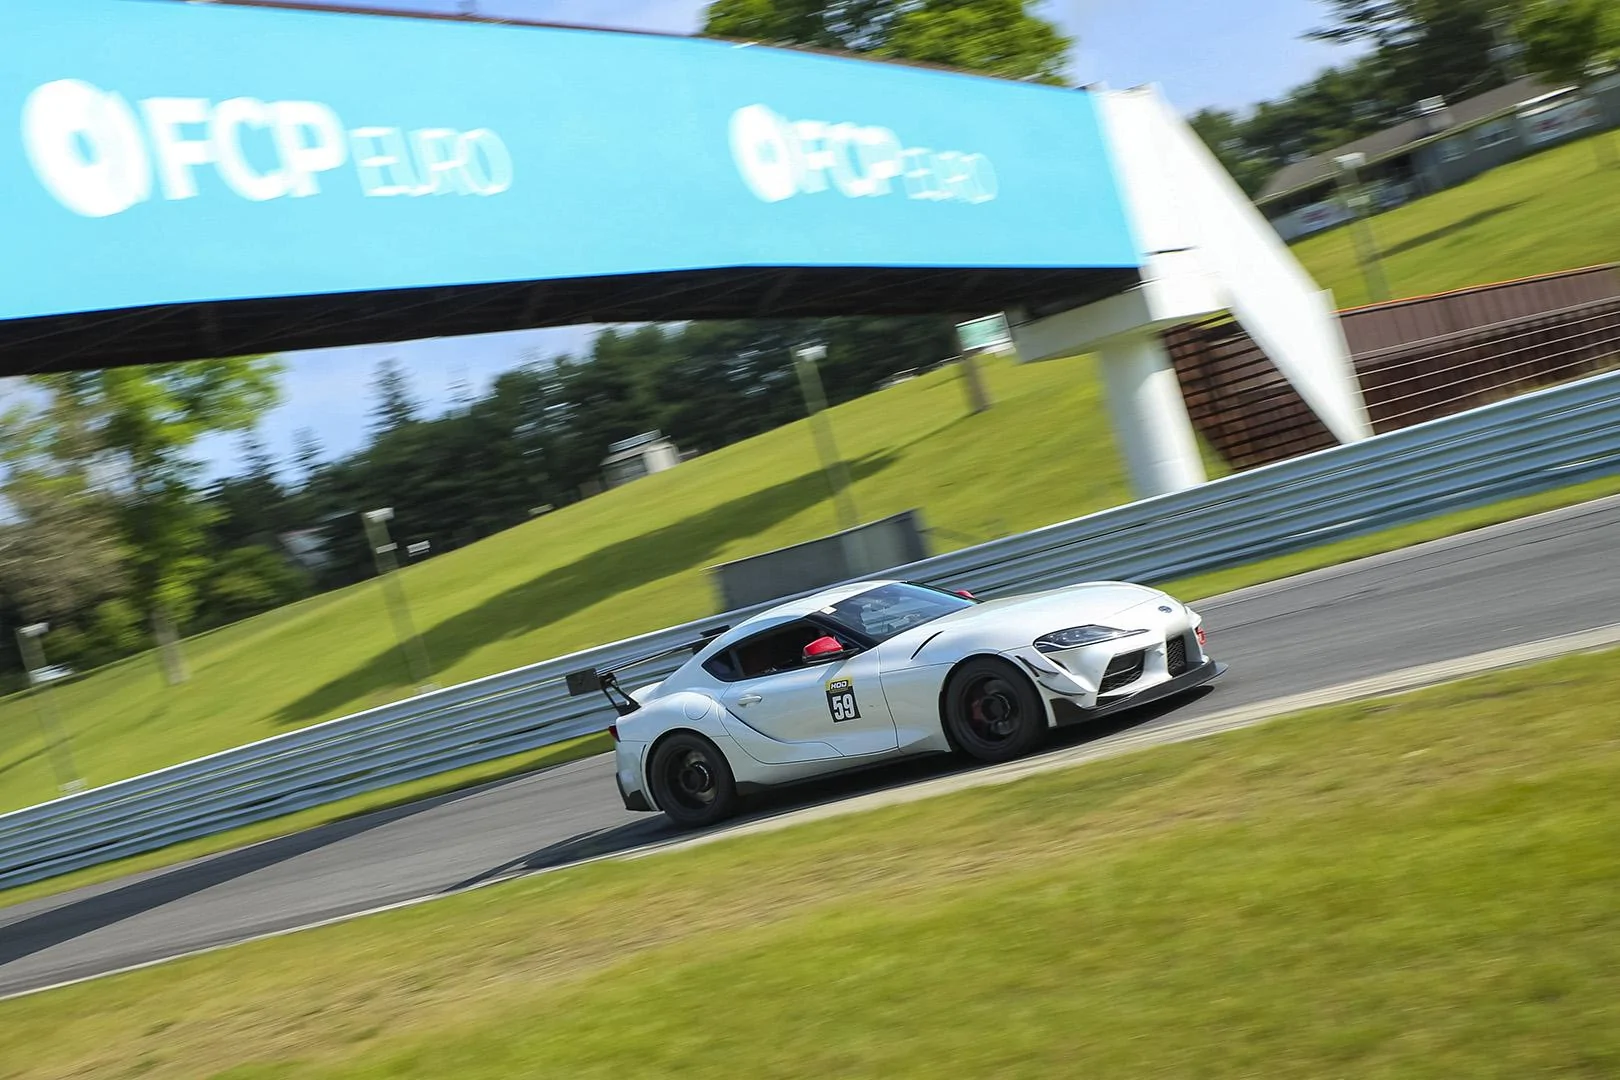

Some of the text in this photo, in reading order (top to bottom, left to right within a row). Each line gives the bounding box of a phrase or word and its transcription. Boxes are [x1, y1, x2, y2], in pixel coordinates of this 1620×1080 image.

[140, 96, 513, 201] FCP EURO
[788, 119, 904, 198] FCP
[832, 693, 855, 720] 59
